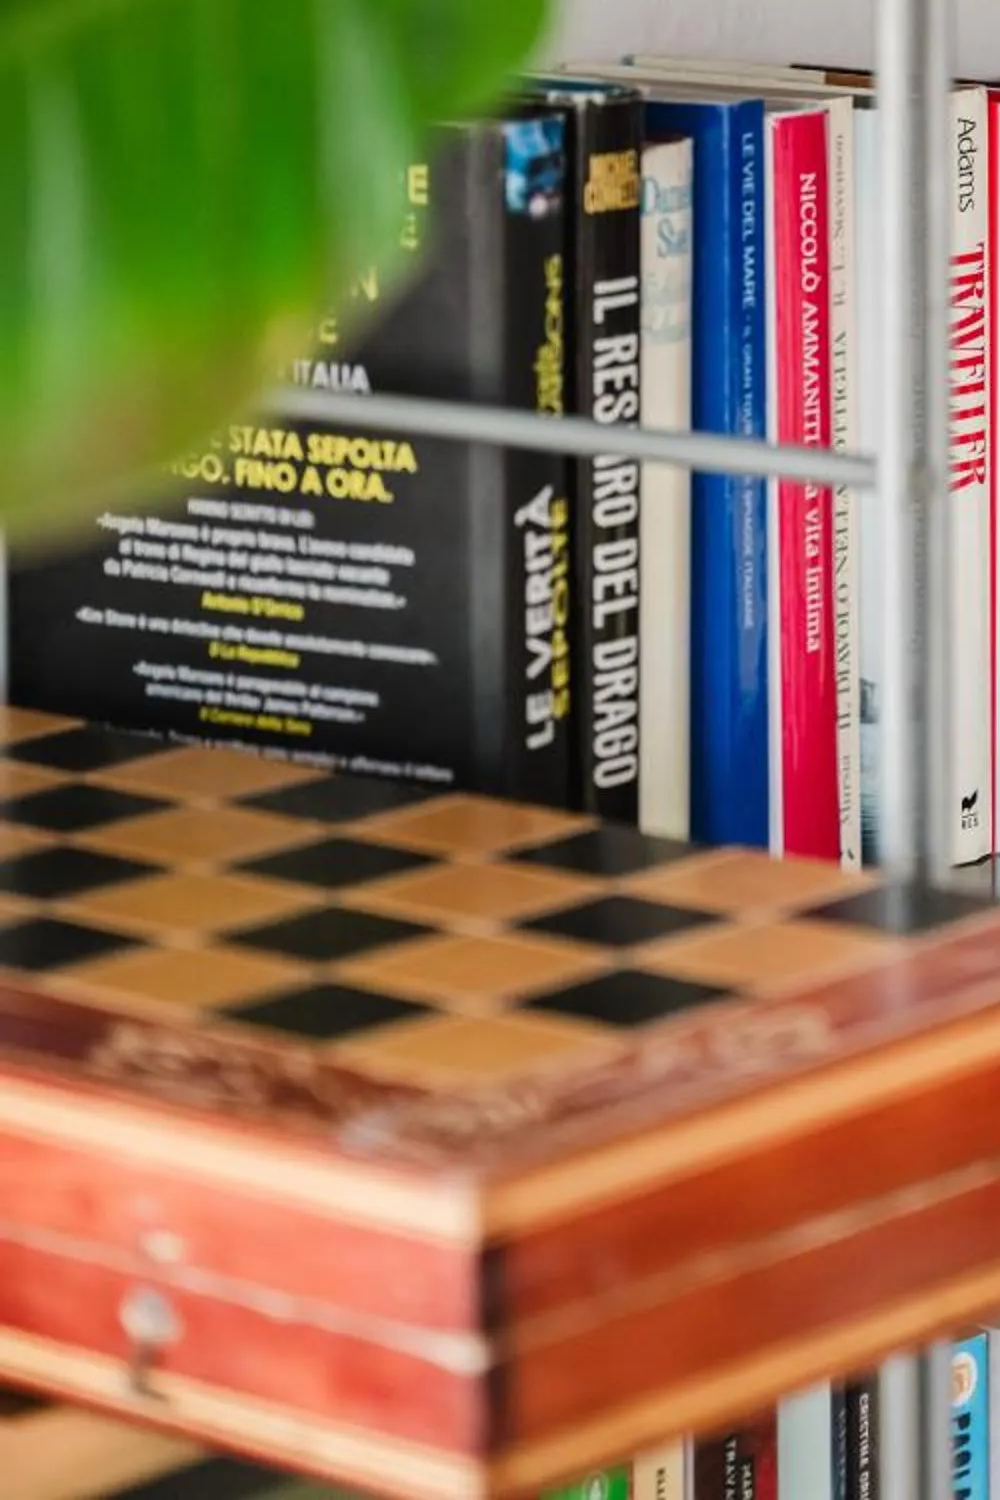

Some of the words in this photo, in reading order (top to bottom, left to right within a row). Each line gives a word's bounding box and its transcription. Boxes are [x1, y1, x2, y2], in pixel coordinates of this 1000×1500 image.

[742, 132, 755, 155] LE
[957, 117, 977, 213] Adams
[742, 160, 755, 197] VIE
[741, 200, 755, 242] DEL
[799, 173, 819, 293] NICCOLÒ
[593, 277, 638, 324] IL
[742, 247, 756, 308] MARE
[801, 301, 821, 444] AMMANITI
[228, 426, 303, 462] STATA
[302, 467, 323, 496] A
[804, 508, 824, 558] vita
[514, 484, 554, 680] VERITÀ
[593, 537, 638, 629] DEL
[805, 566, 824, 653] intima
[526, 690, 554, 750] LE
[593, 637, 638, 789] DRAGO
